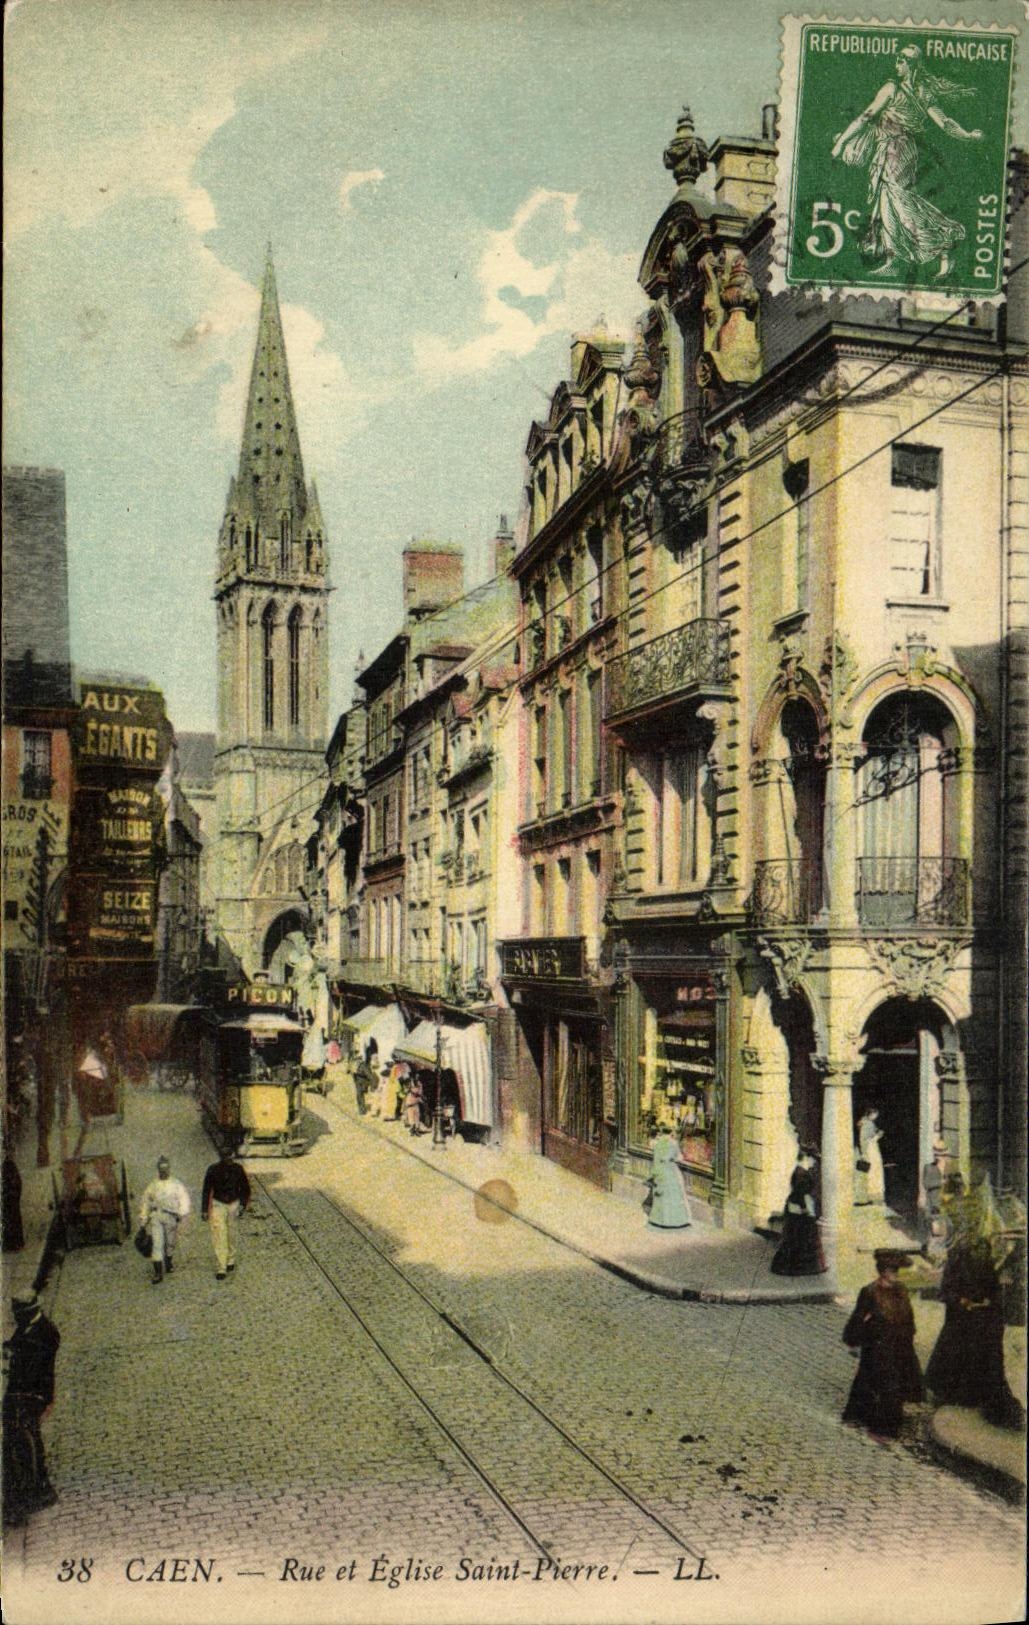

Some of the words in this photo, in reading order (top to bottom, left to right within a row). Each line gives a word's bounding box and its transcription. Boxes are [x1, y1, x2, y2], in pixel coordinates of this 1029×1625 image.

[926, 39, 1008, 62] FRANÇAISE
[974, 194, 999, 278] POSTES
[84, 691, 141, 715] AUX
[103, 891, 151, 910] SEIZE
[228, 987, 293, 1004] PICON
